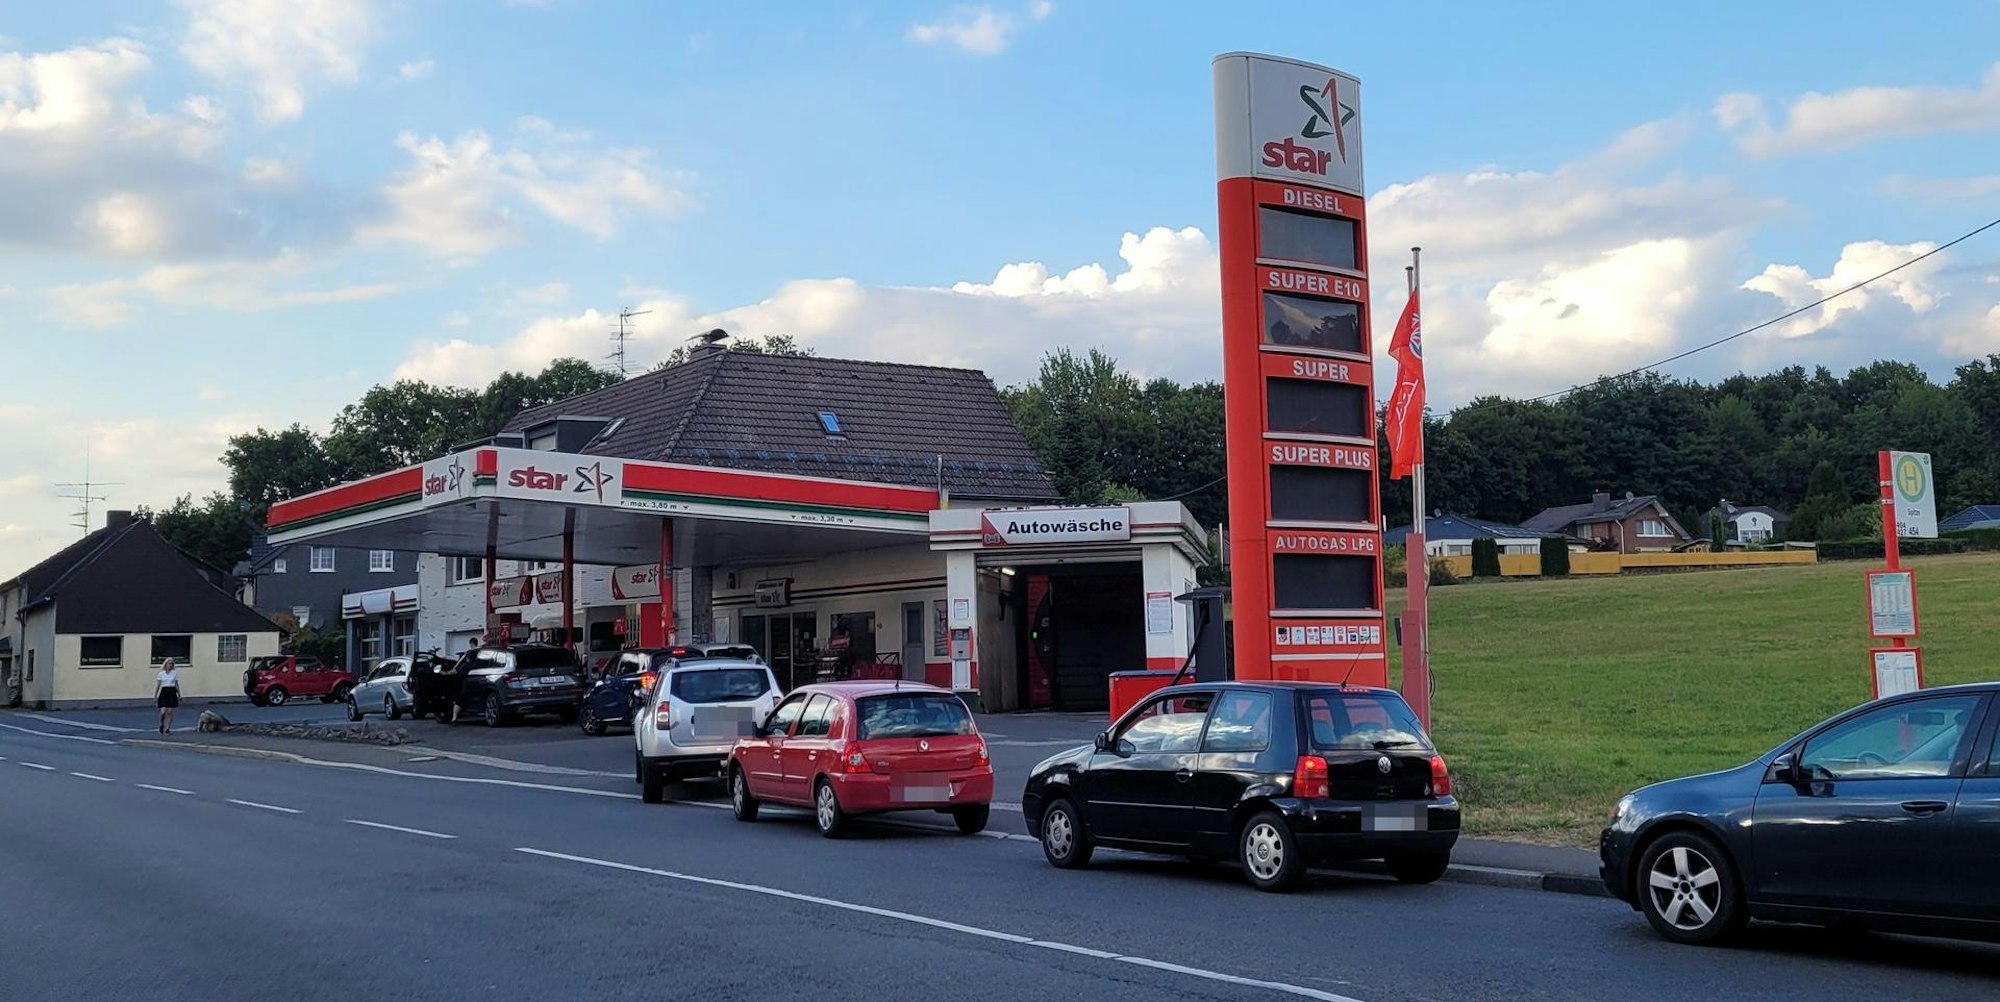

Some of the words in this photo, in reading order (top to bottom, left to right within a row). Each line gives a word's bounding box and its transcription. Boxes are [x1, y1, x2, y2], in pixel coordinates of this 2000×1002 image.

[1262, 138, 1331, 175] star
[1283, 188, 1343, 213] DIESEL
[1269, 271, 1329, 293] SUPER
[1334, 281, 1360, 299] E10
[1293, 360, 1349, 381] SUPER
[1272, 445, 1331, 465] SUPER
[1335, 449, 1371, 468] PLUS
[424, 471, 448, 496] star
[508, 465, 569, 491] star
[629, 501, 650, 509] max.
[1007, 518, 1123, 534] Autowäsche
[1275, 535, 1347, 552] AUTOGAS
[1352, 537, 1374, 552] LPG
[631, 571, 648, 584] star
